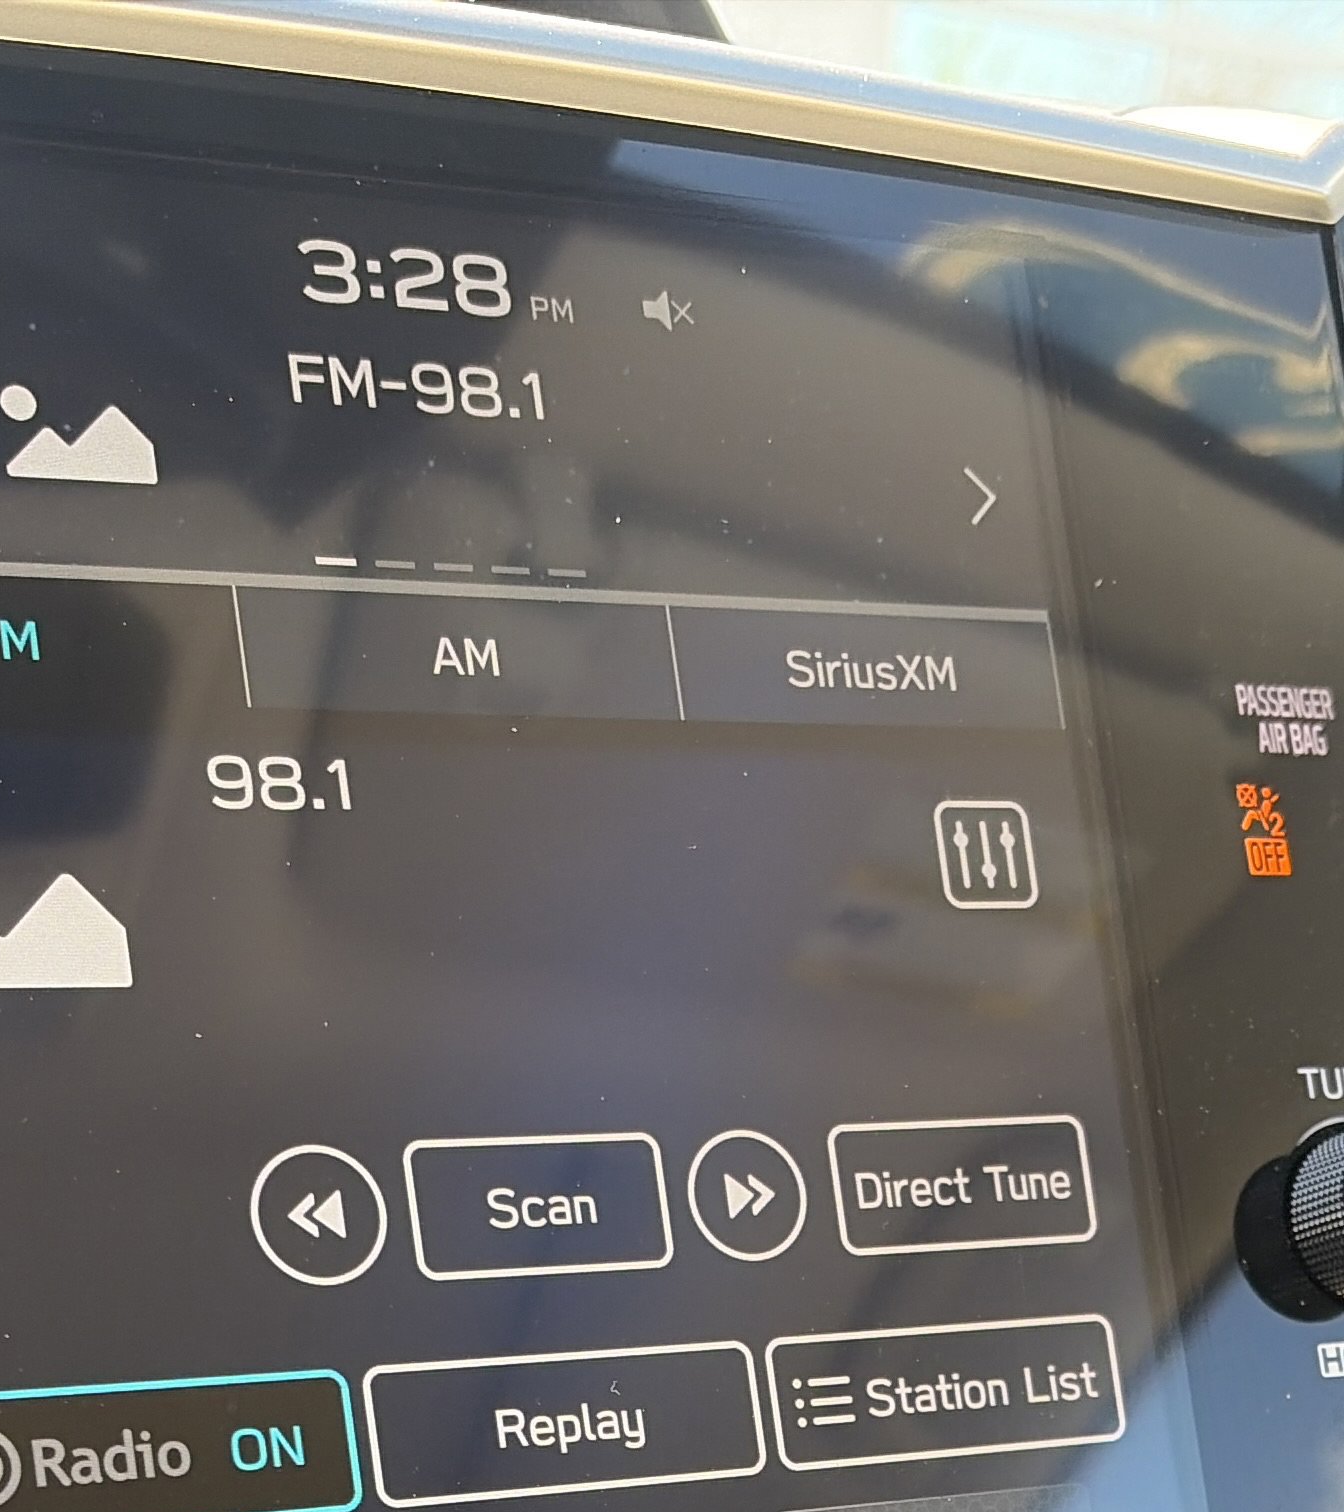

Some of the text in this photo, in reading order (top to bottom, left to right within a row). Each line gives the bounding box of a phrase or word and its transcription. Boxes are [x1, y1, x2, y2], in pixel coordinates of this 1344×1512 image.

[297, 239, 574, 323] 3:28 PM
[287, 353, 548, 421] FM-98.1
[433, 637, 501, 678] AM
[785, 650, 958, 694] SiriusXM
[1234, 684, 1335, 720] PASSENGER
[1259, 721, 1328, 756] AIR BAG
[206, 755, 353, 812] 98.1
[1248, 842, 1287, 872] OFF
[486, 1187, 598, 1229] Scan
[854, 1165, 1073, 1212] Direct Tune
[865, 1362, 1099, 1416] Station List
[230, 1426, 306, 1472] ON
[495, 1403, 648, 1456] Replay
[31, 1428, 192, 1488] Radio
